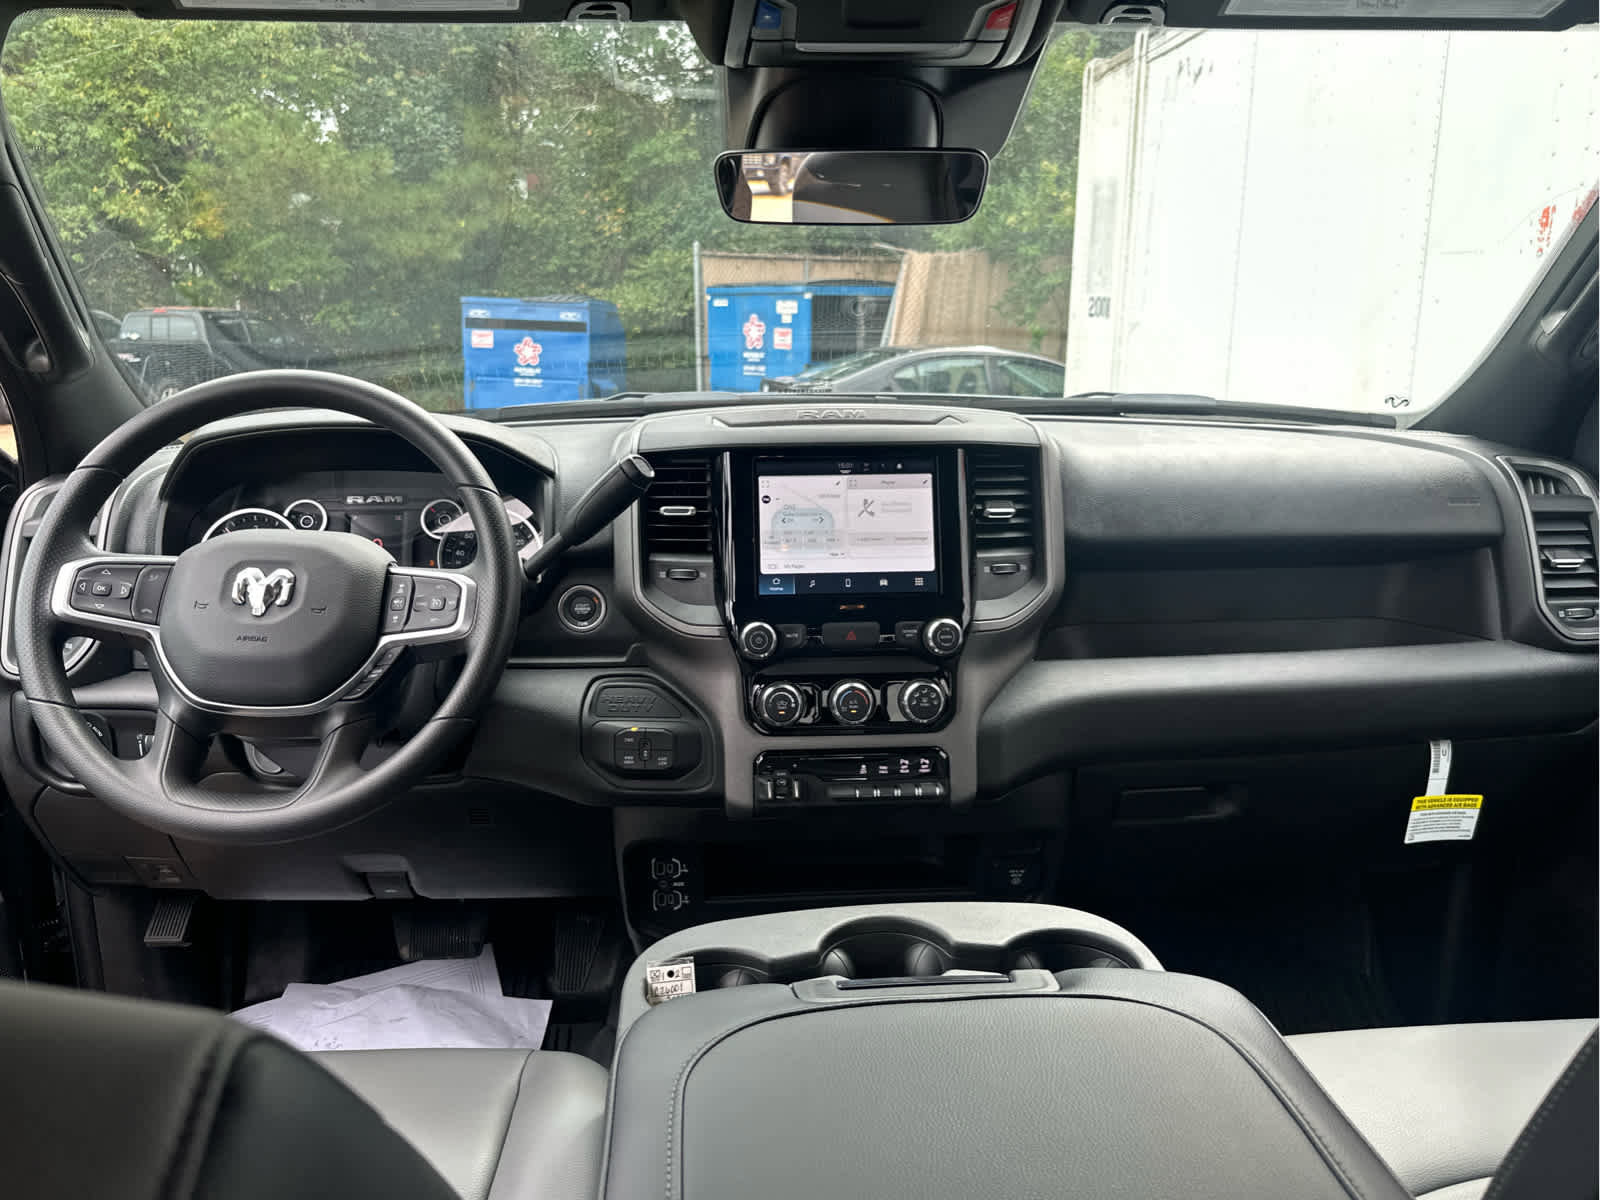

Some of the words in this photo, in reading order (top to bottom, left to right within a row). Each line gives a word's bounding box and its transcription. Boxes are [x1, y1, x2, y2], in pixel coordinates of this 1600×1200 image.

[797, 408, 865, 420] RAM
[346, 495, 403, 504] RAM
[236, 634, 269, 643] AIRBAG
